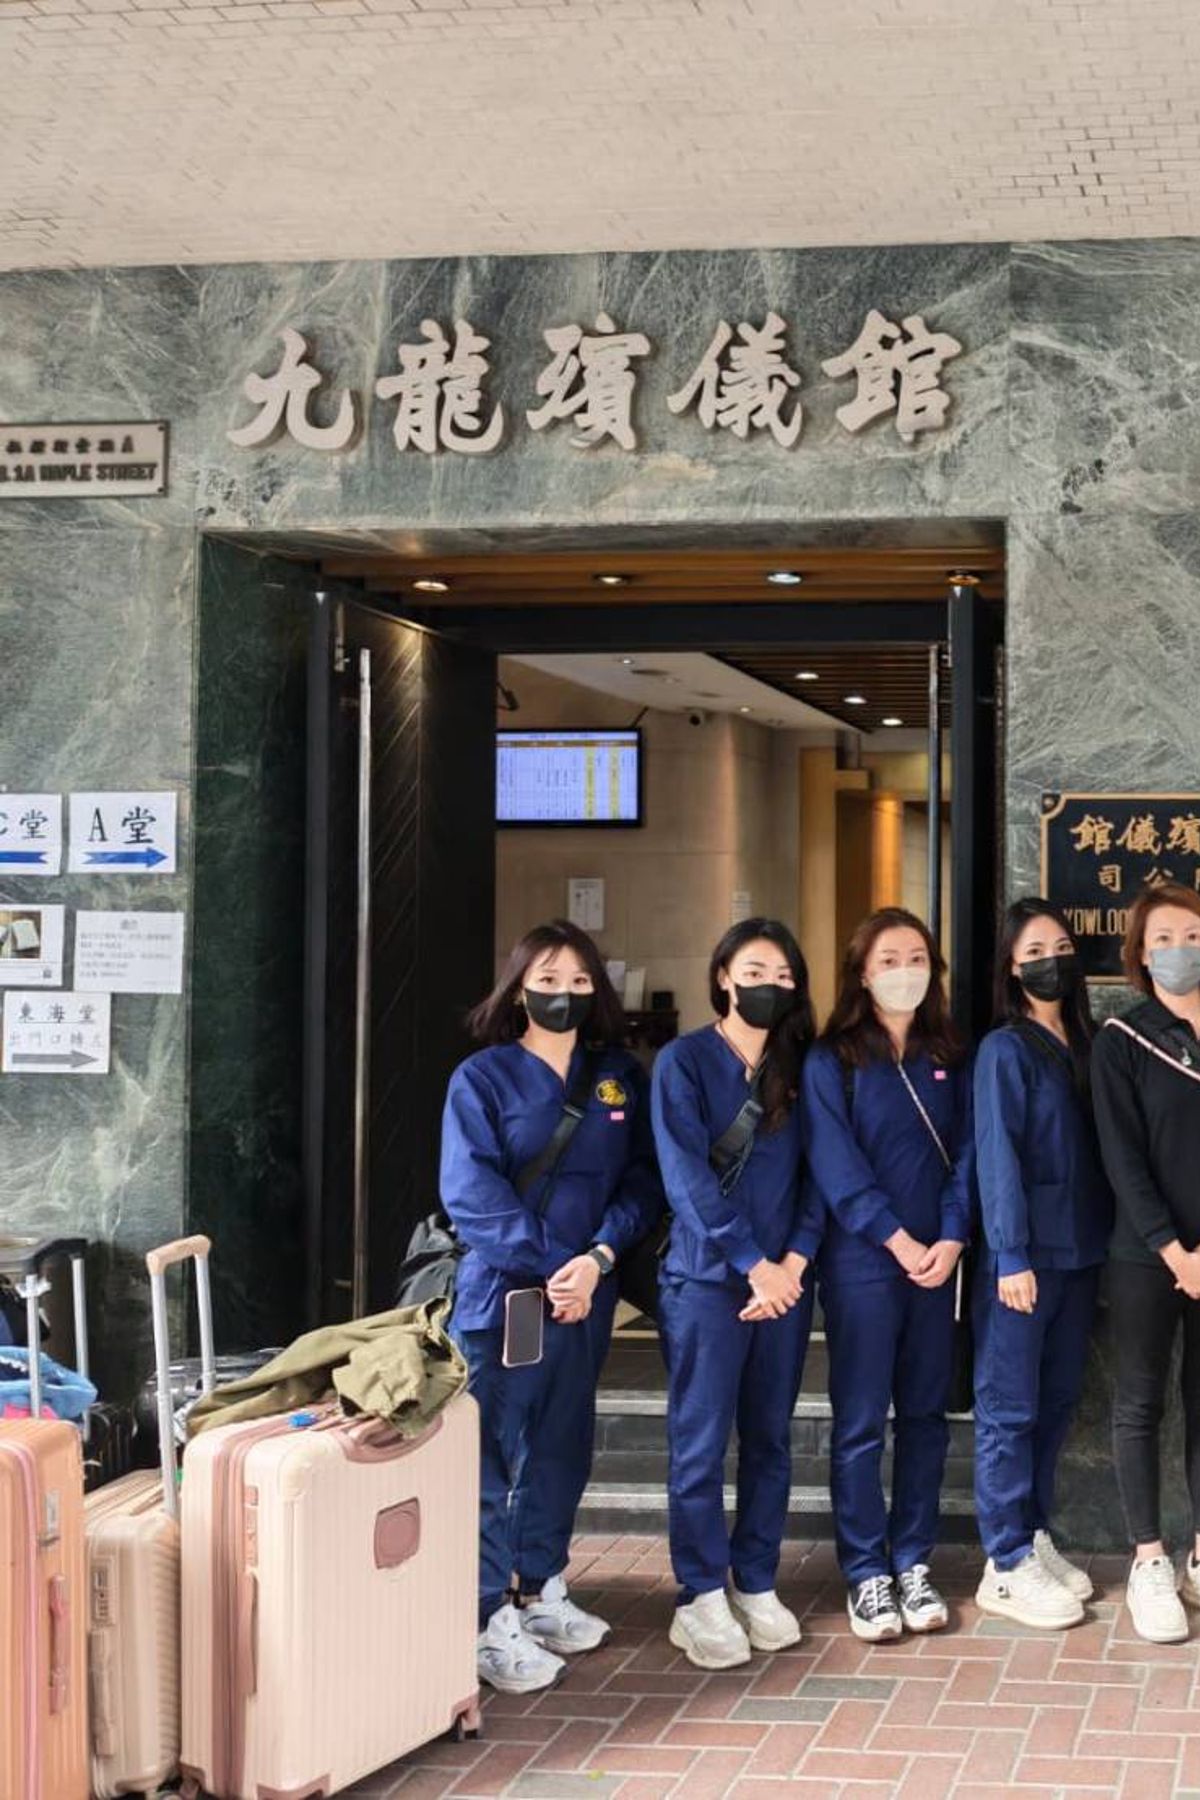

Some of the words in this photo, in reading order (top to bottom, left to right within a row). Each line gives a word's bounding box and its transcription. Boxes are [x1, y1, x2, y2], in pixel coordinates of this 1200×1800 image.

[226, 309, 963, 453] 九龍殯儀館
